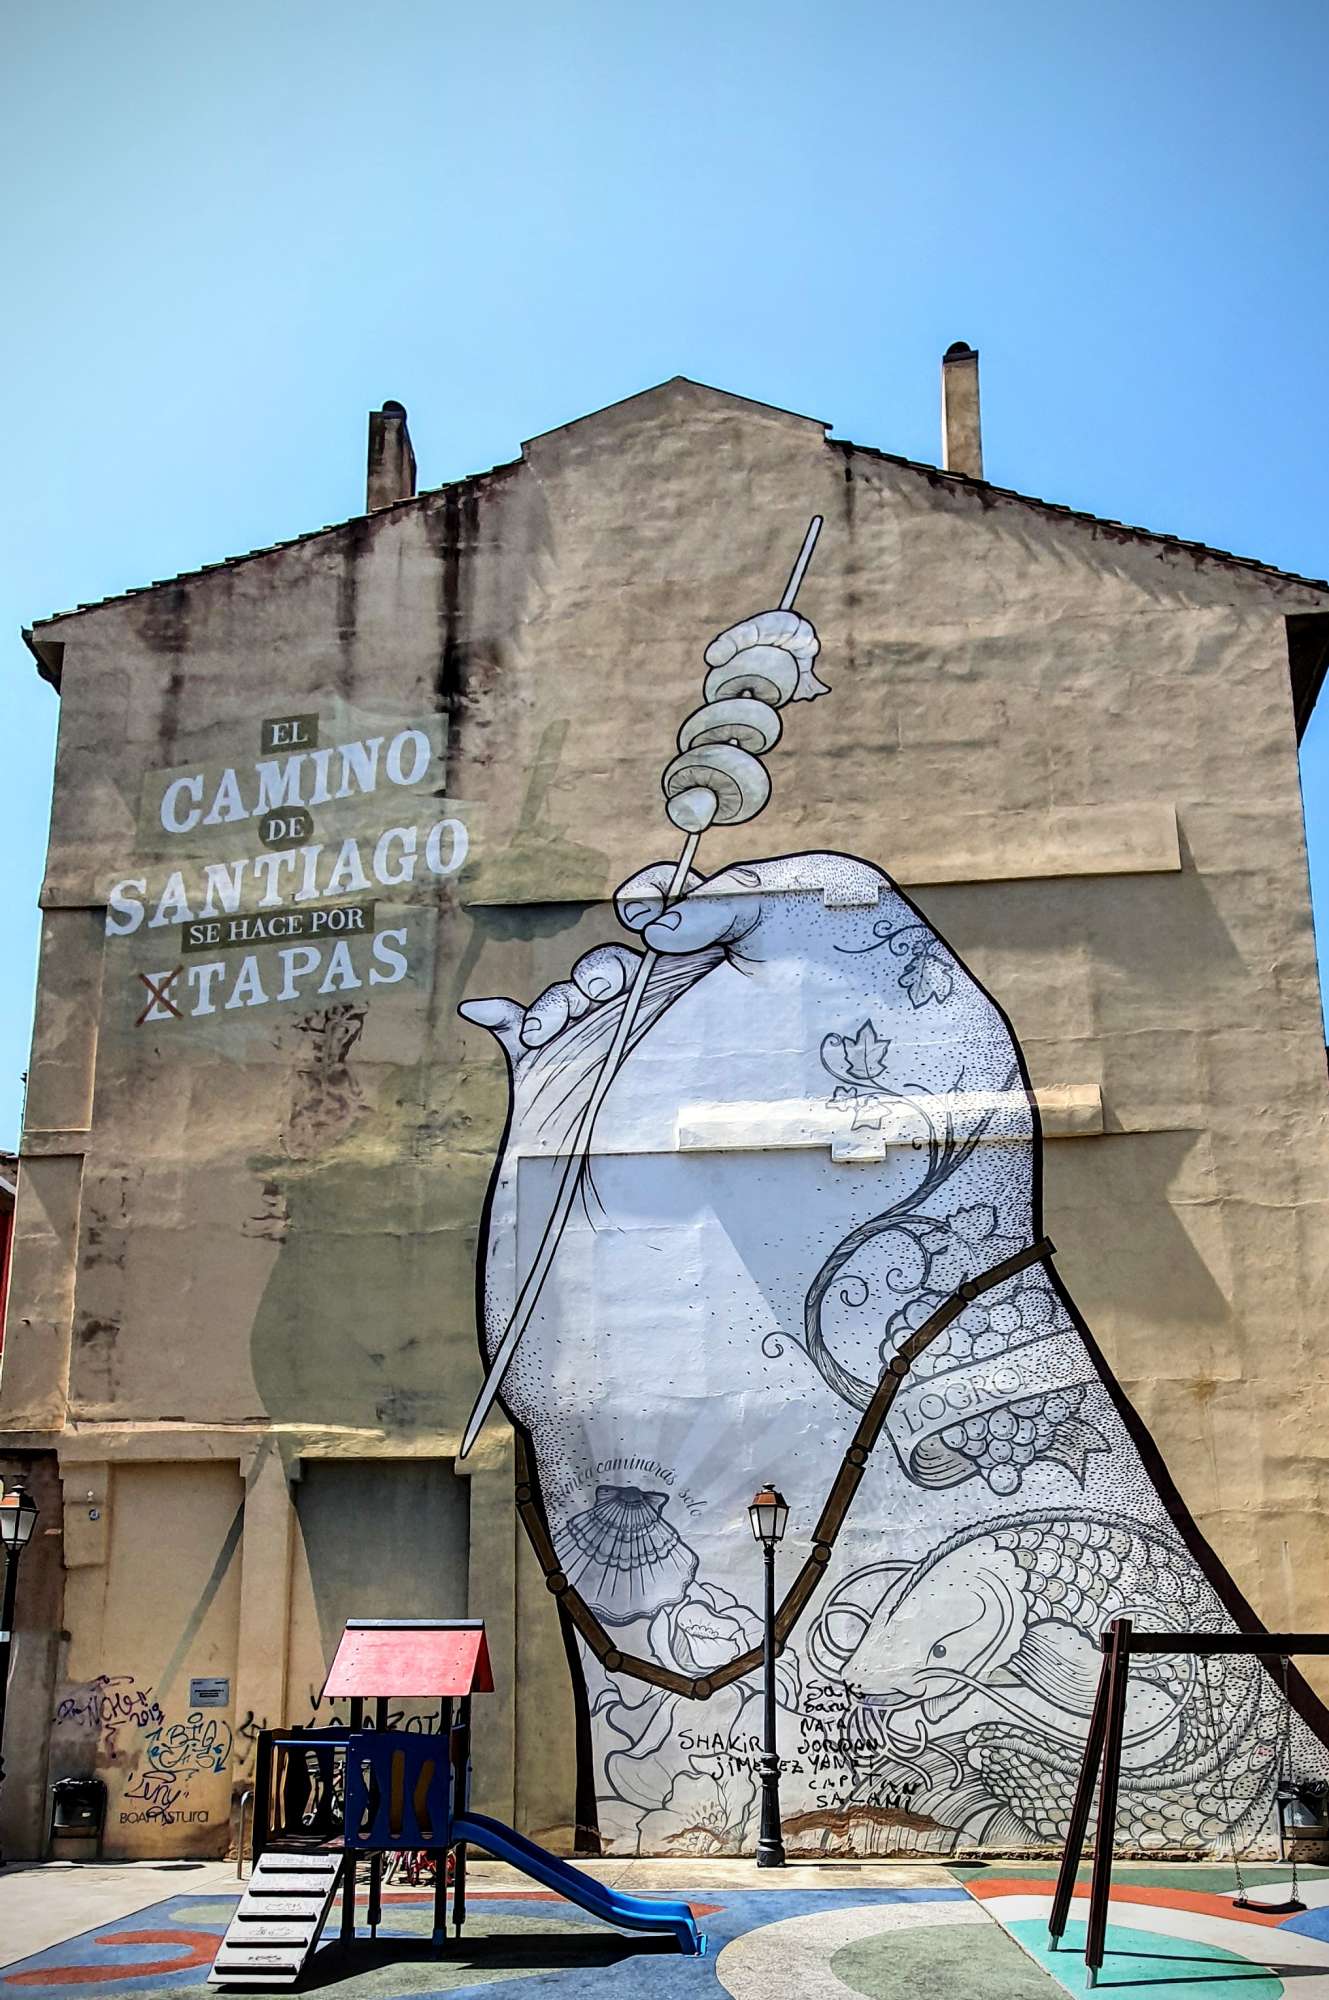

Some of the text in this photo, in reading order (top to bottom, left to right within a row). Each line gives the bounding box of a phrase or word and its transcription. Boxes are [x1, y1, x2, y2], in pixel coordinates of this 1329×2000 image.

[271, 721, 308, 746] EL
[160, 729, 432, 833] CAMINO
[268, 816, 306, 842] DE
[105, 818, 470, 937] SANTIAGO
[190, 908, 365, 945] SE HACE POR
[800, 1718, 847, 1737] NATA
[797, 1738, 880, 1755] JORDAN
